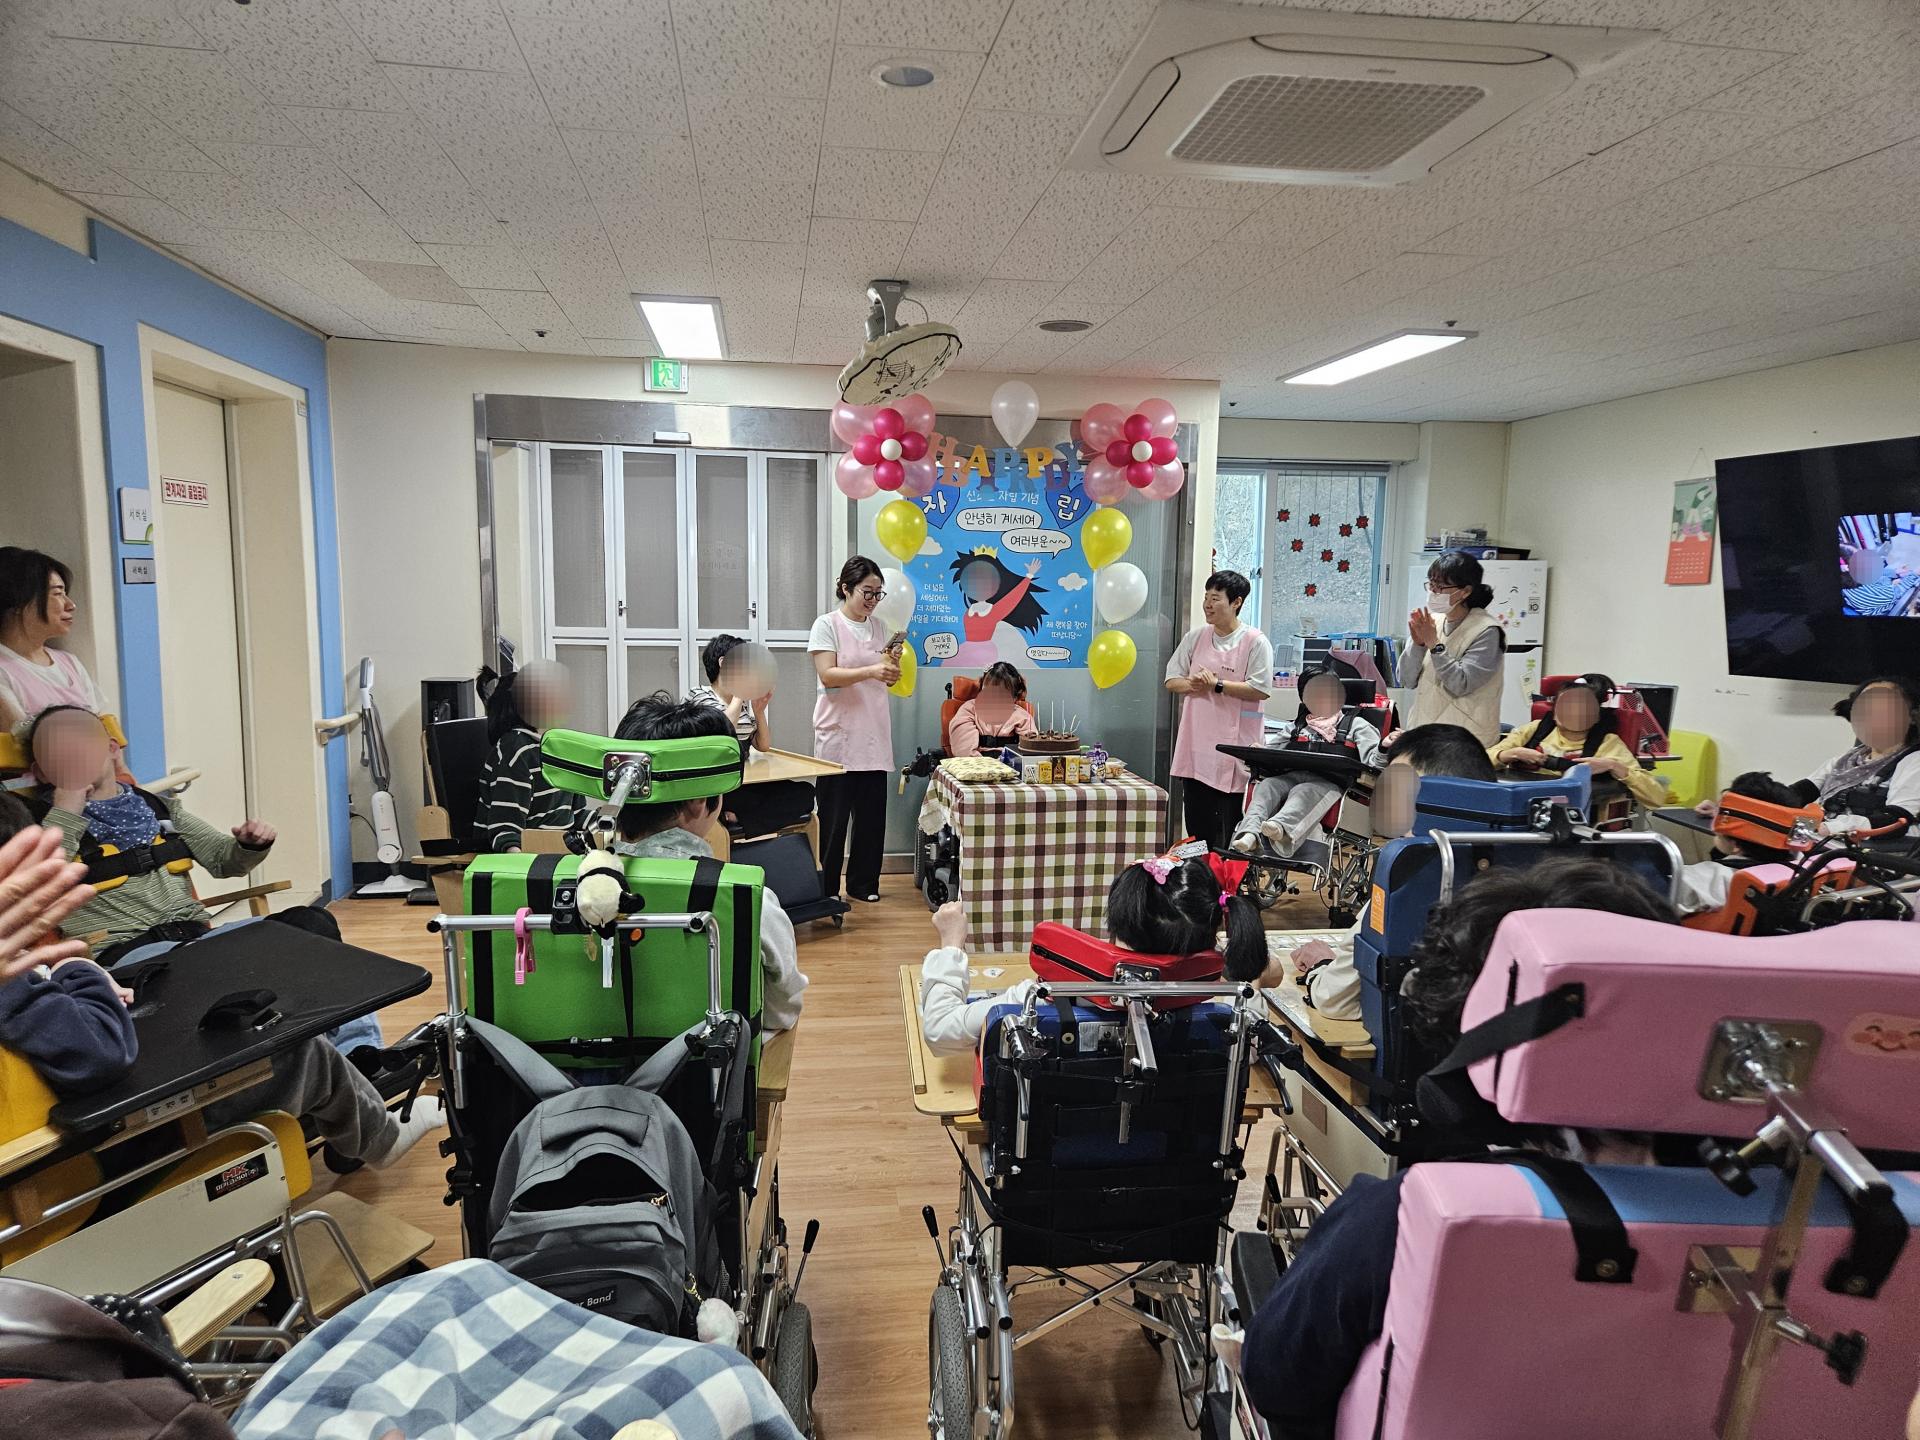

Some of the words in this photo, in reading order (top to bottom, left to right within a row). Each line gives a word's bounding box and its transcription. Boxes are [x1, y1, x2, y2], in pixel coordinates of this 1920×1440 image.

[927, 432, 1085, 478] HAPPY
[922, 490, 948, 514] 자
[1021, 492, 1040, 505] 기념
[1057, 494, 1081, 521] 립
[964, 511, 997, 526] 안녕히
[1001, 512, 1036, 526] 계세여
[920, 593, 948, 602] 세상에서
[916, 604, 924, 612] 더
[586, 1292, 612, 1307] Band
